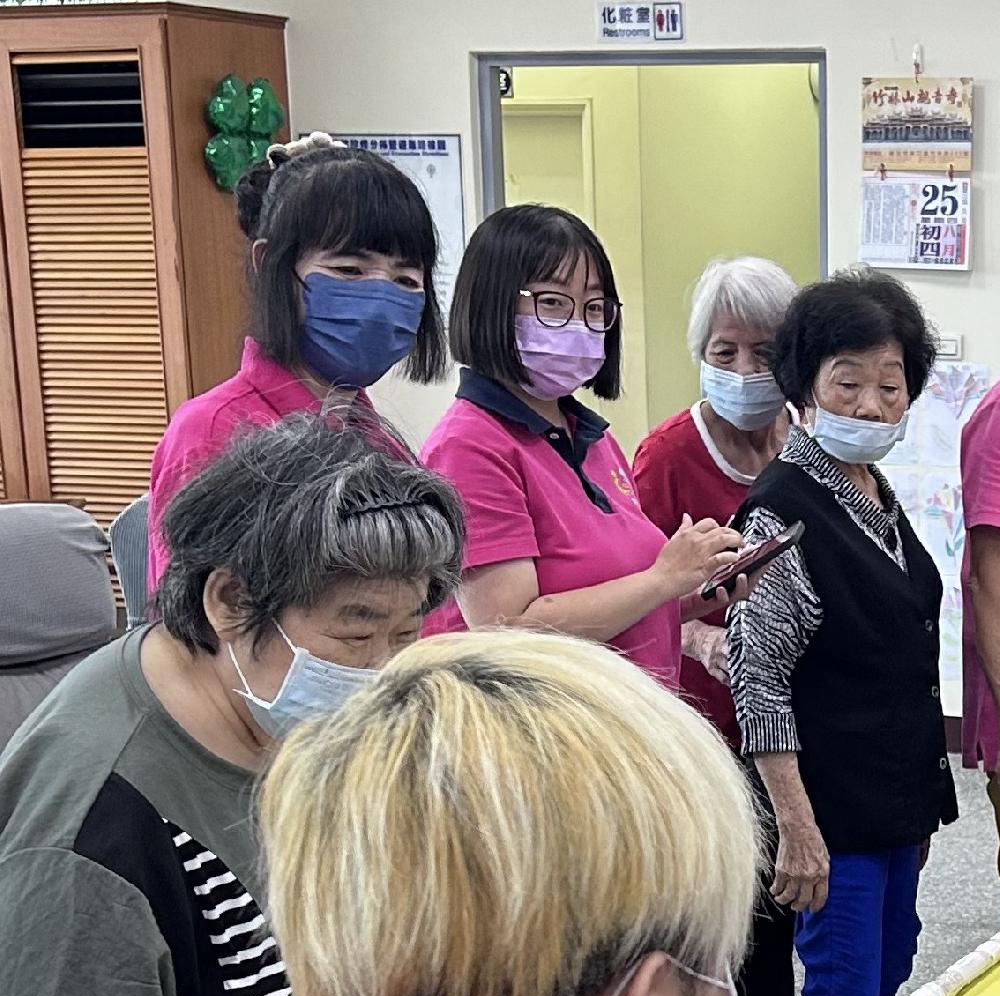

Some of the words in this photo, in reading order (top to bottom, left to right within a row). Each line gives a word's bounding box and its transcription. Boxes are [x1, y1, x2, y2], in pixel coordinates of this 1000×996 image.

[602, 6, 650, 24] 化粧室
[603, 28, 650, 37] Restrooms
[920, 184, 959, 216] 25
[920, 225, 942, 257] 初四
